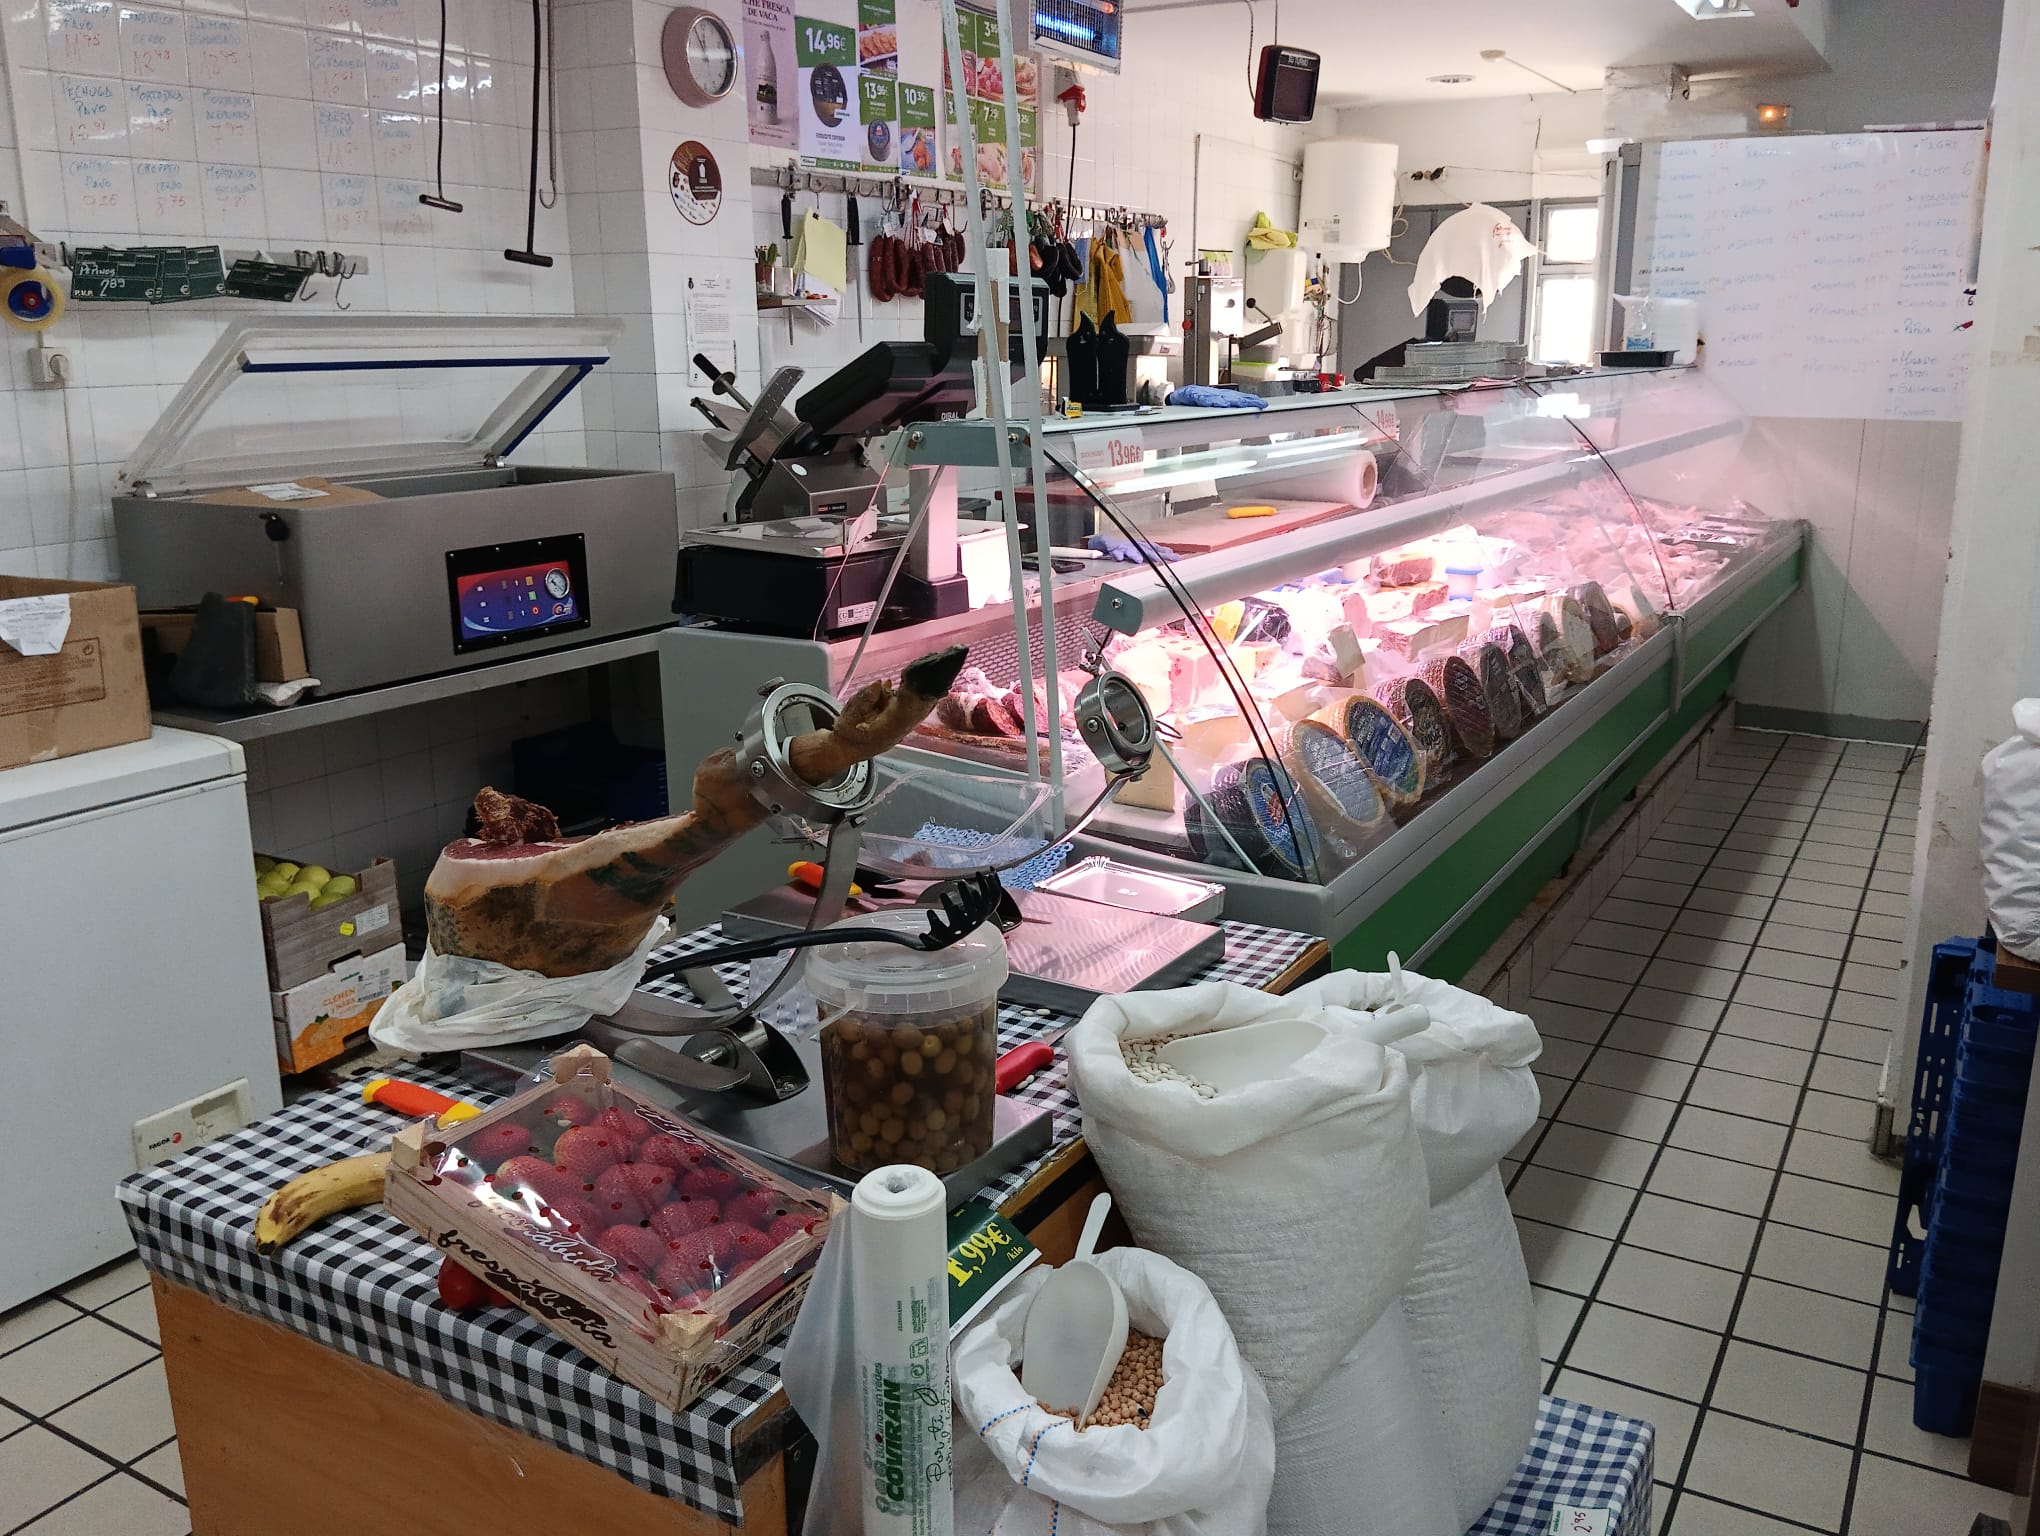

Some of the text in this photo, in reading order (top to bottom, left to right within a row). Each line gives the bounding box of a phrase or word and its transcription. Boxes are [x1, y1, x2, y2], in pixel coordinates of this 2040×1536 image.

[747, 8, 778, 22] DE VACA
[763, 0, 791, 16] FRESCA
[78, 262, 116, 276] PEPINOS
[940, 410, 960, 422] DIBAL
[148, 1137, 171, 1151] FAGOR
[1005, 1246, 1025, 1262] /kilo
[874, 1362, 884, 1392] redes
[883, 1378, 905, 1502] COVIRAN
